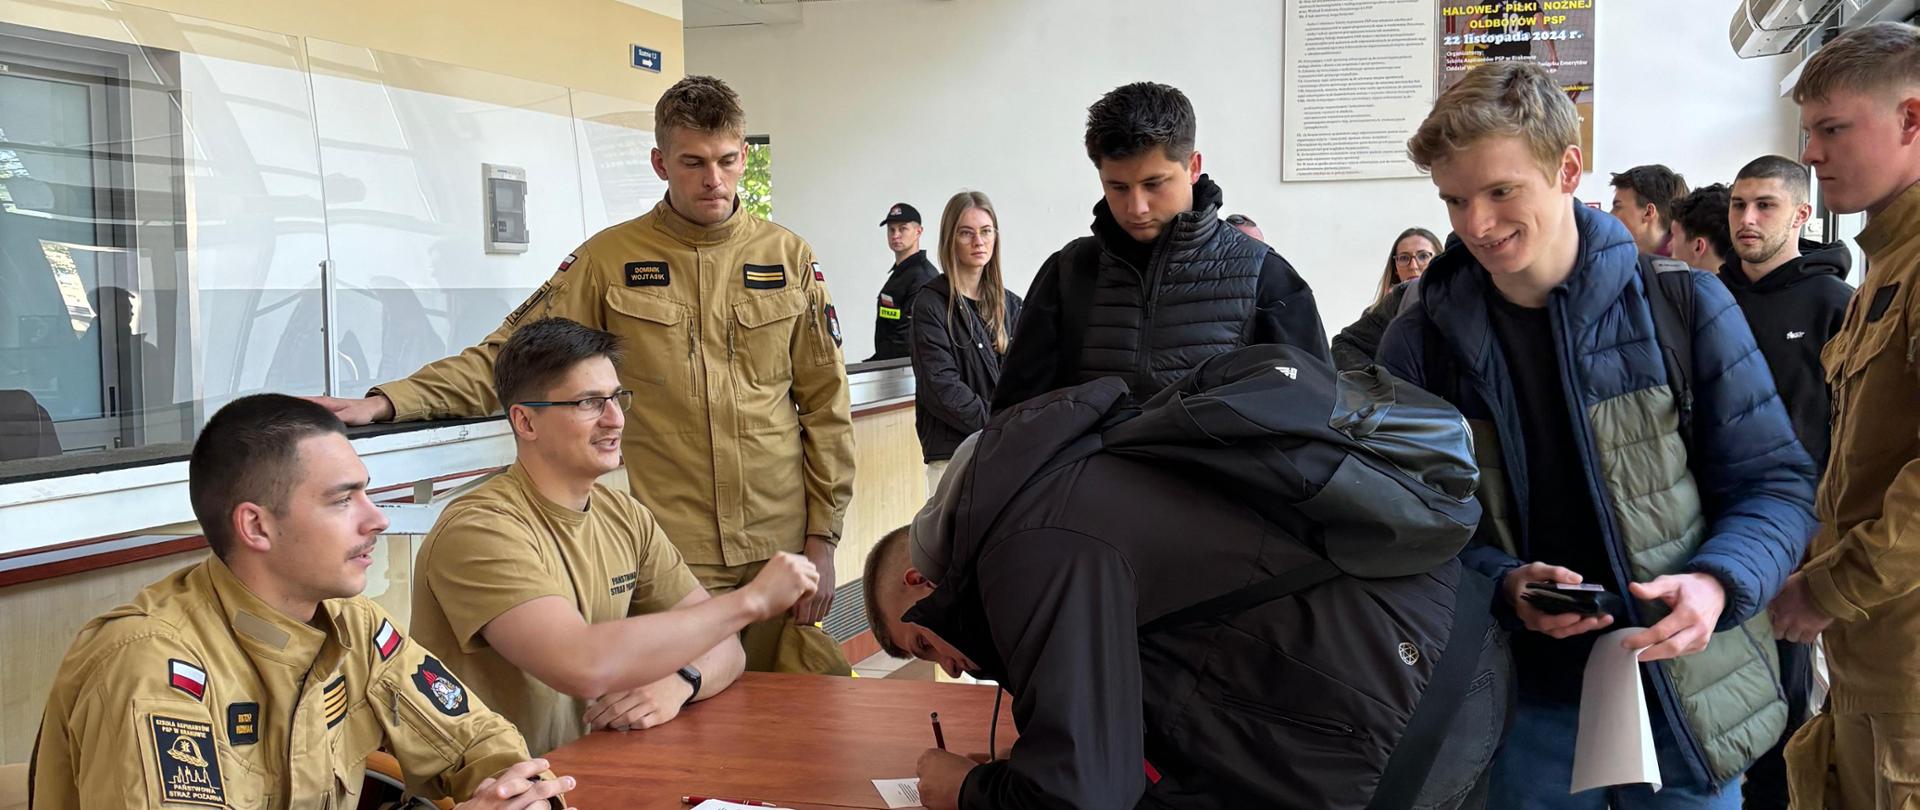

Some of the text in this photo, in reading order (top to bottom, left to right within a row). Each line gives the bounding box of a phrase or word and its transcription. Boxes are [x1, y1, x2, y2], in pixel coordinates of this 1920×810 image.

[1442, 0, 1592, 16] HALOWEJ PIŁKI NOŻNEJ
[1469, 15, 1566, 29] OLDBOYÓW PSP
[1443, 30, 1583, 45] 22 listopada 2024 r.
[630, 273, 665, 281] WOJTASIK
[173, 783, 216, 794] PAŃSTWOWA
[192, 792, 224, 802] POŻARNA
